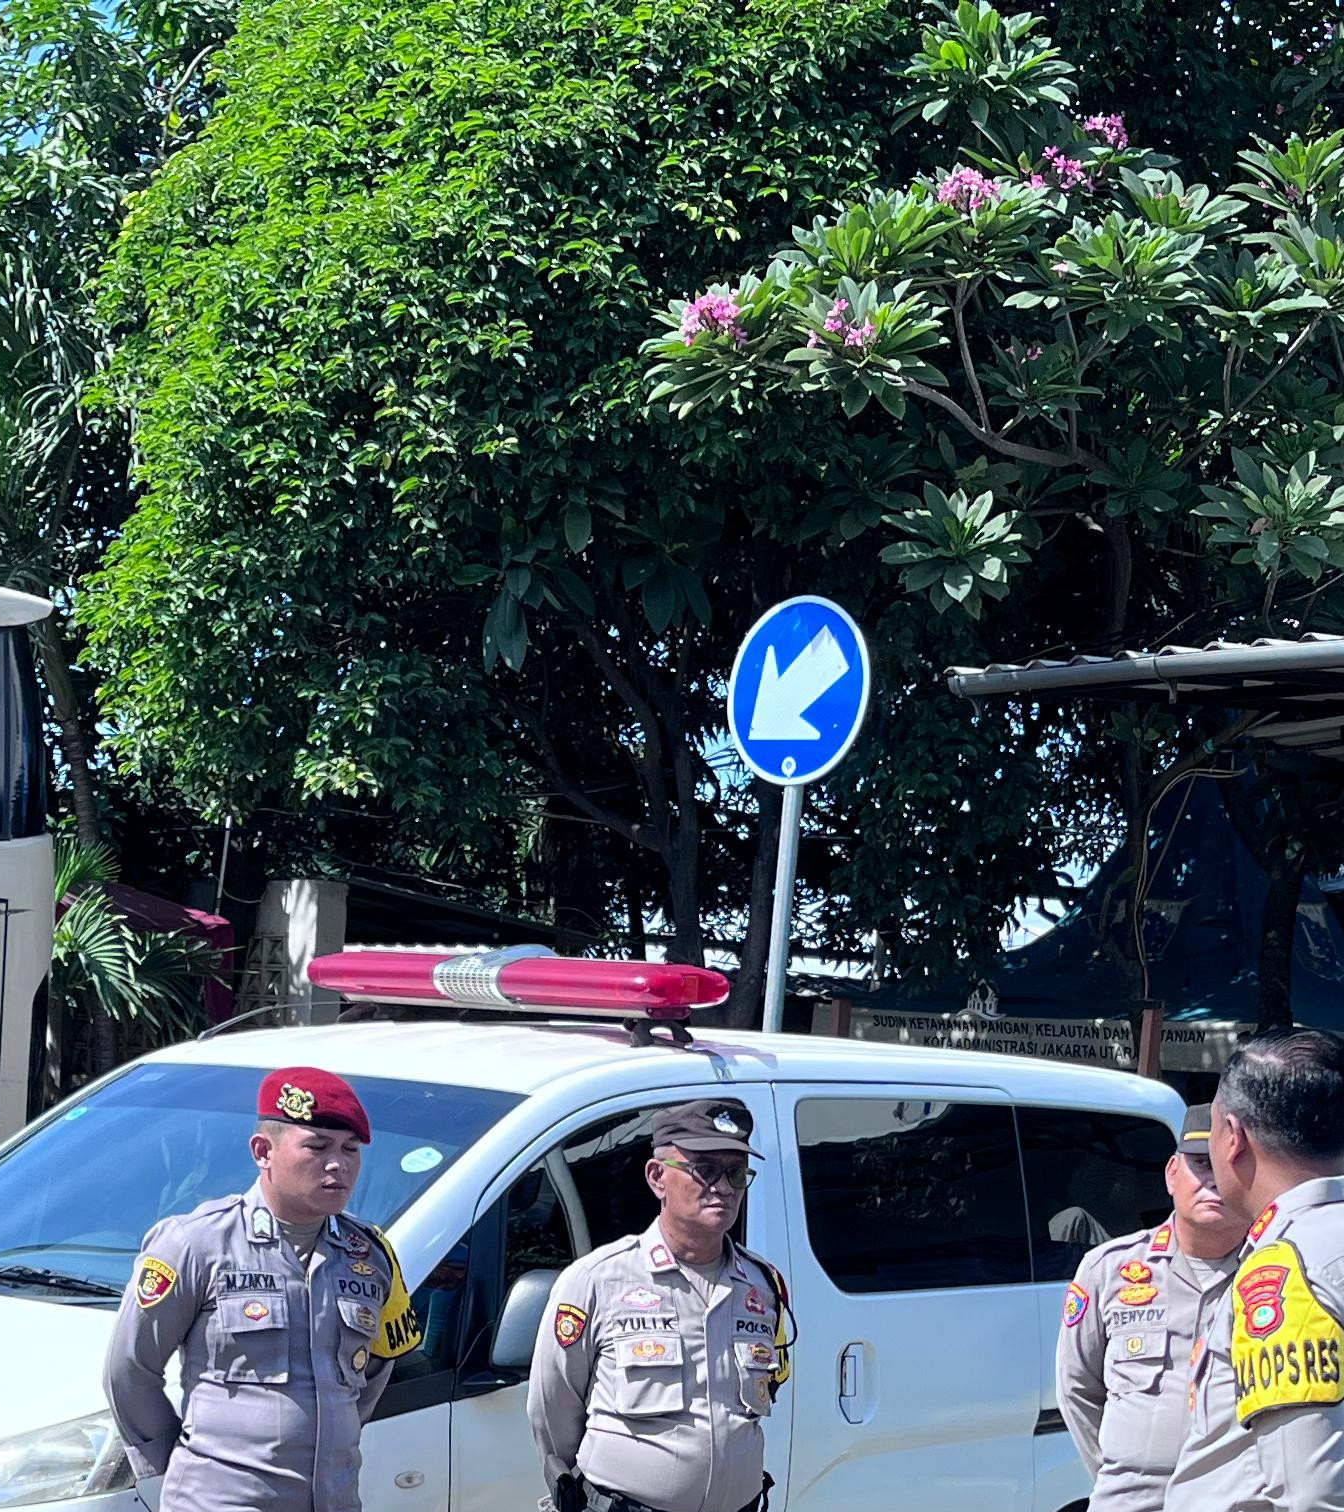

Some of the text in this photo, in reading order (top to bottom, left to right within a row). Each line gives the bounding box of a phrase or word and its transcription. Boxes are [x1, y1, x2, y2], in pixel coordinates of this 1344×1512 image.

[873, 1014, 906, 1028] SUDIN
[909, 1016, 978, 1033] KETAHANAN
[1035, 1023, 1100, 1039] KELAUTAN
[1103, 1027, 1129, 1041] DAN
[955, 1037, 1038, 1056] ADMINISTRASI
[1041, 1043, 1095, 1058] JAKARTA
[338, 1280, 381, 1301] POLRI
[1303, 1340, 1341, 1386] RES
